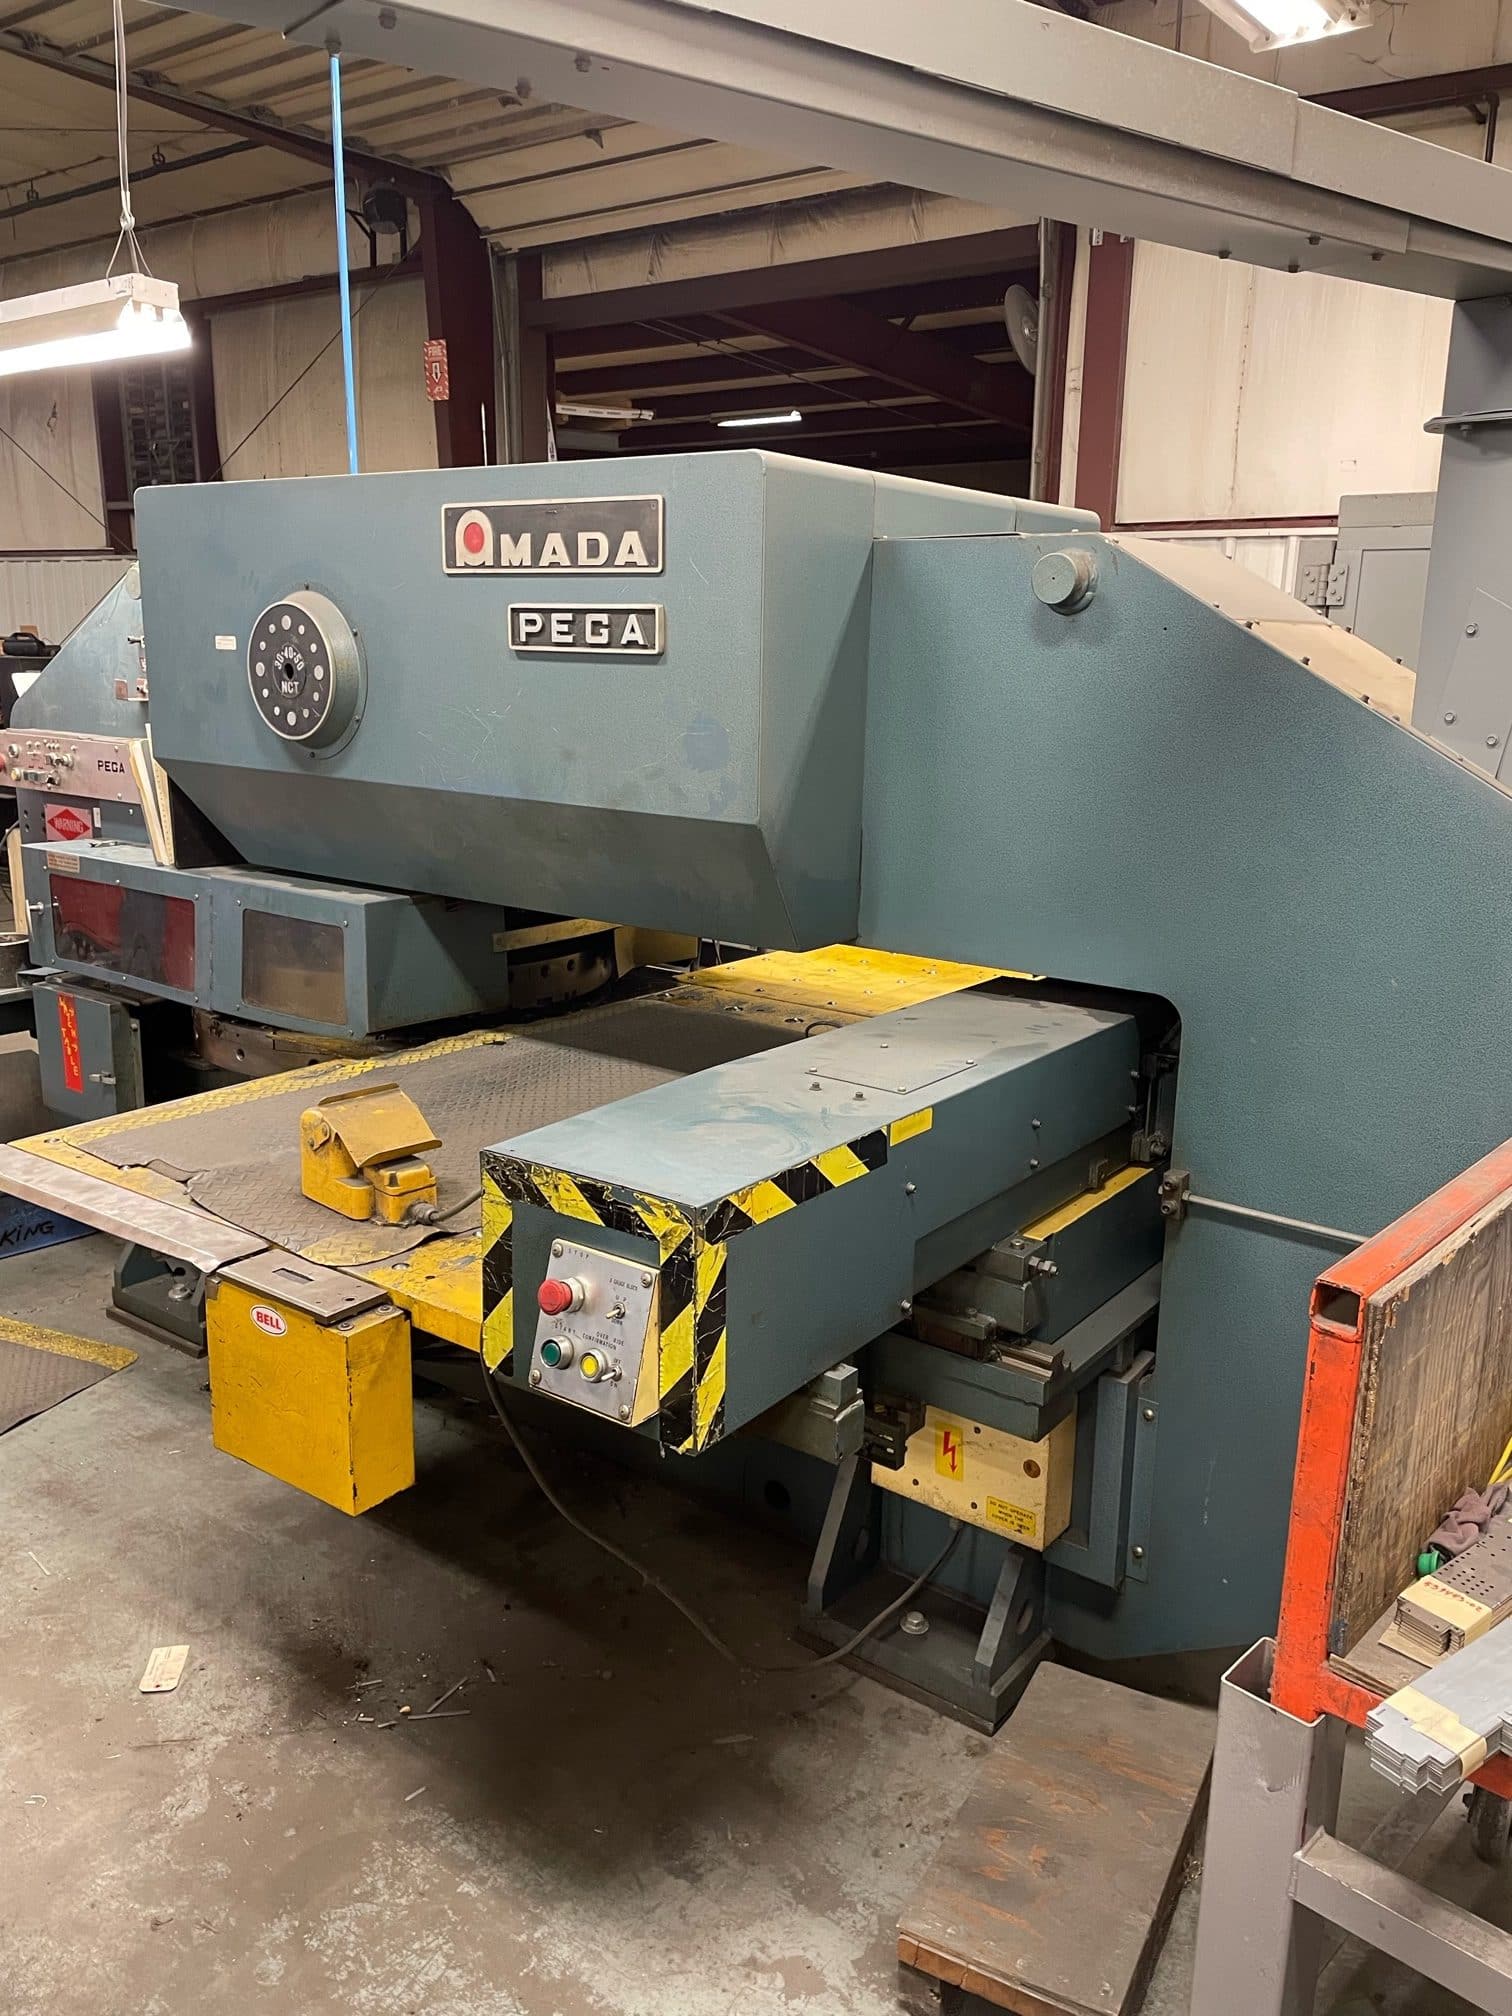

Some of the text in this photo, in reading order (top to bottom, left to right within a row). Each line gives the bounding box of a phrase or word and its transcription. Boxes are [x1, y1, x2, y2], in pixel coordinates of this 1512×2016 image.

[455, 509, 649, 567] AMADA
[518, 612, 649, 646] PEGA
[281, 680, 299, 694] NCT
[97, 759, 126, 774] PEGA
[568, 1248, 589, 1260] STOP
[256, 1310, 282, 1331] BELL
[582, 1332, 617, 1350] CONFIRMATION
[596, 1331, 609, 1341] OVER
